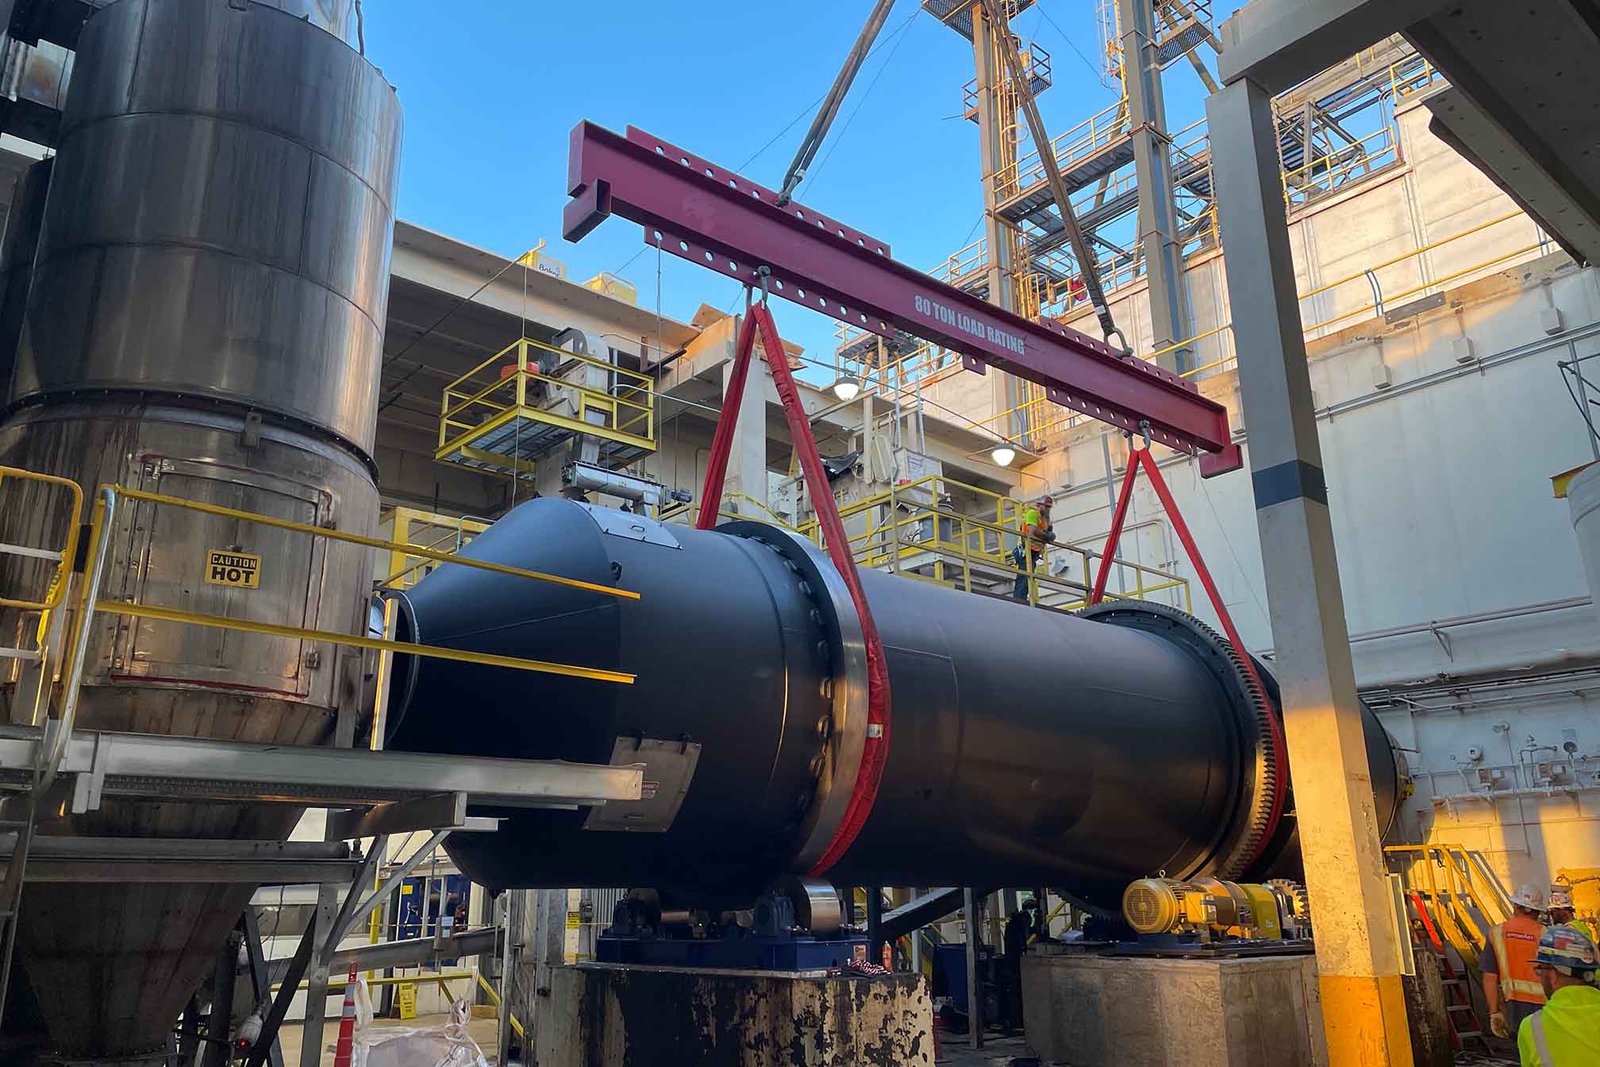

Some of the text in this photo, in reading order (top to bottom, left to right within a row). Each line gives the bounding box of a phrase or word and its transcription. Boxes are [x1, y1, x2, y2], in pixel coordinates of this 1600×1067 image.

[914, 294, 1025, 356] 80 TON LOAD RATING
[212, 554, 257, 569] CAUTION
[211, 566, 255, 584] HOT
